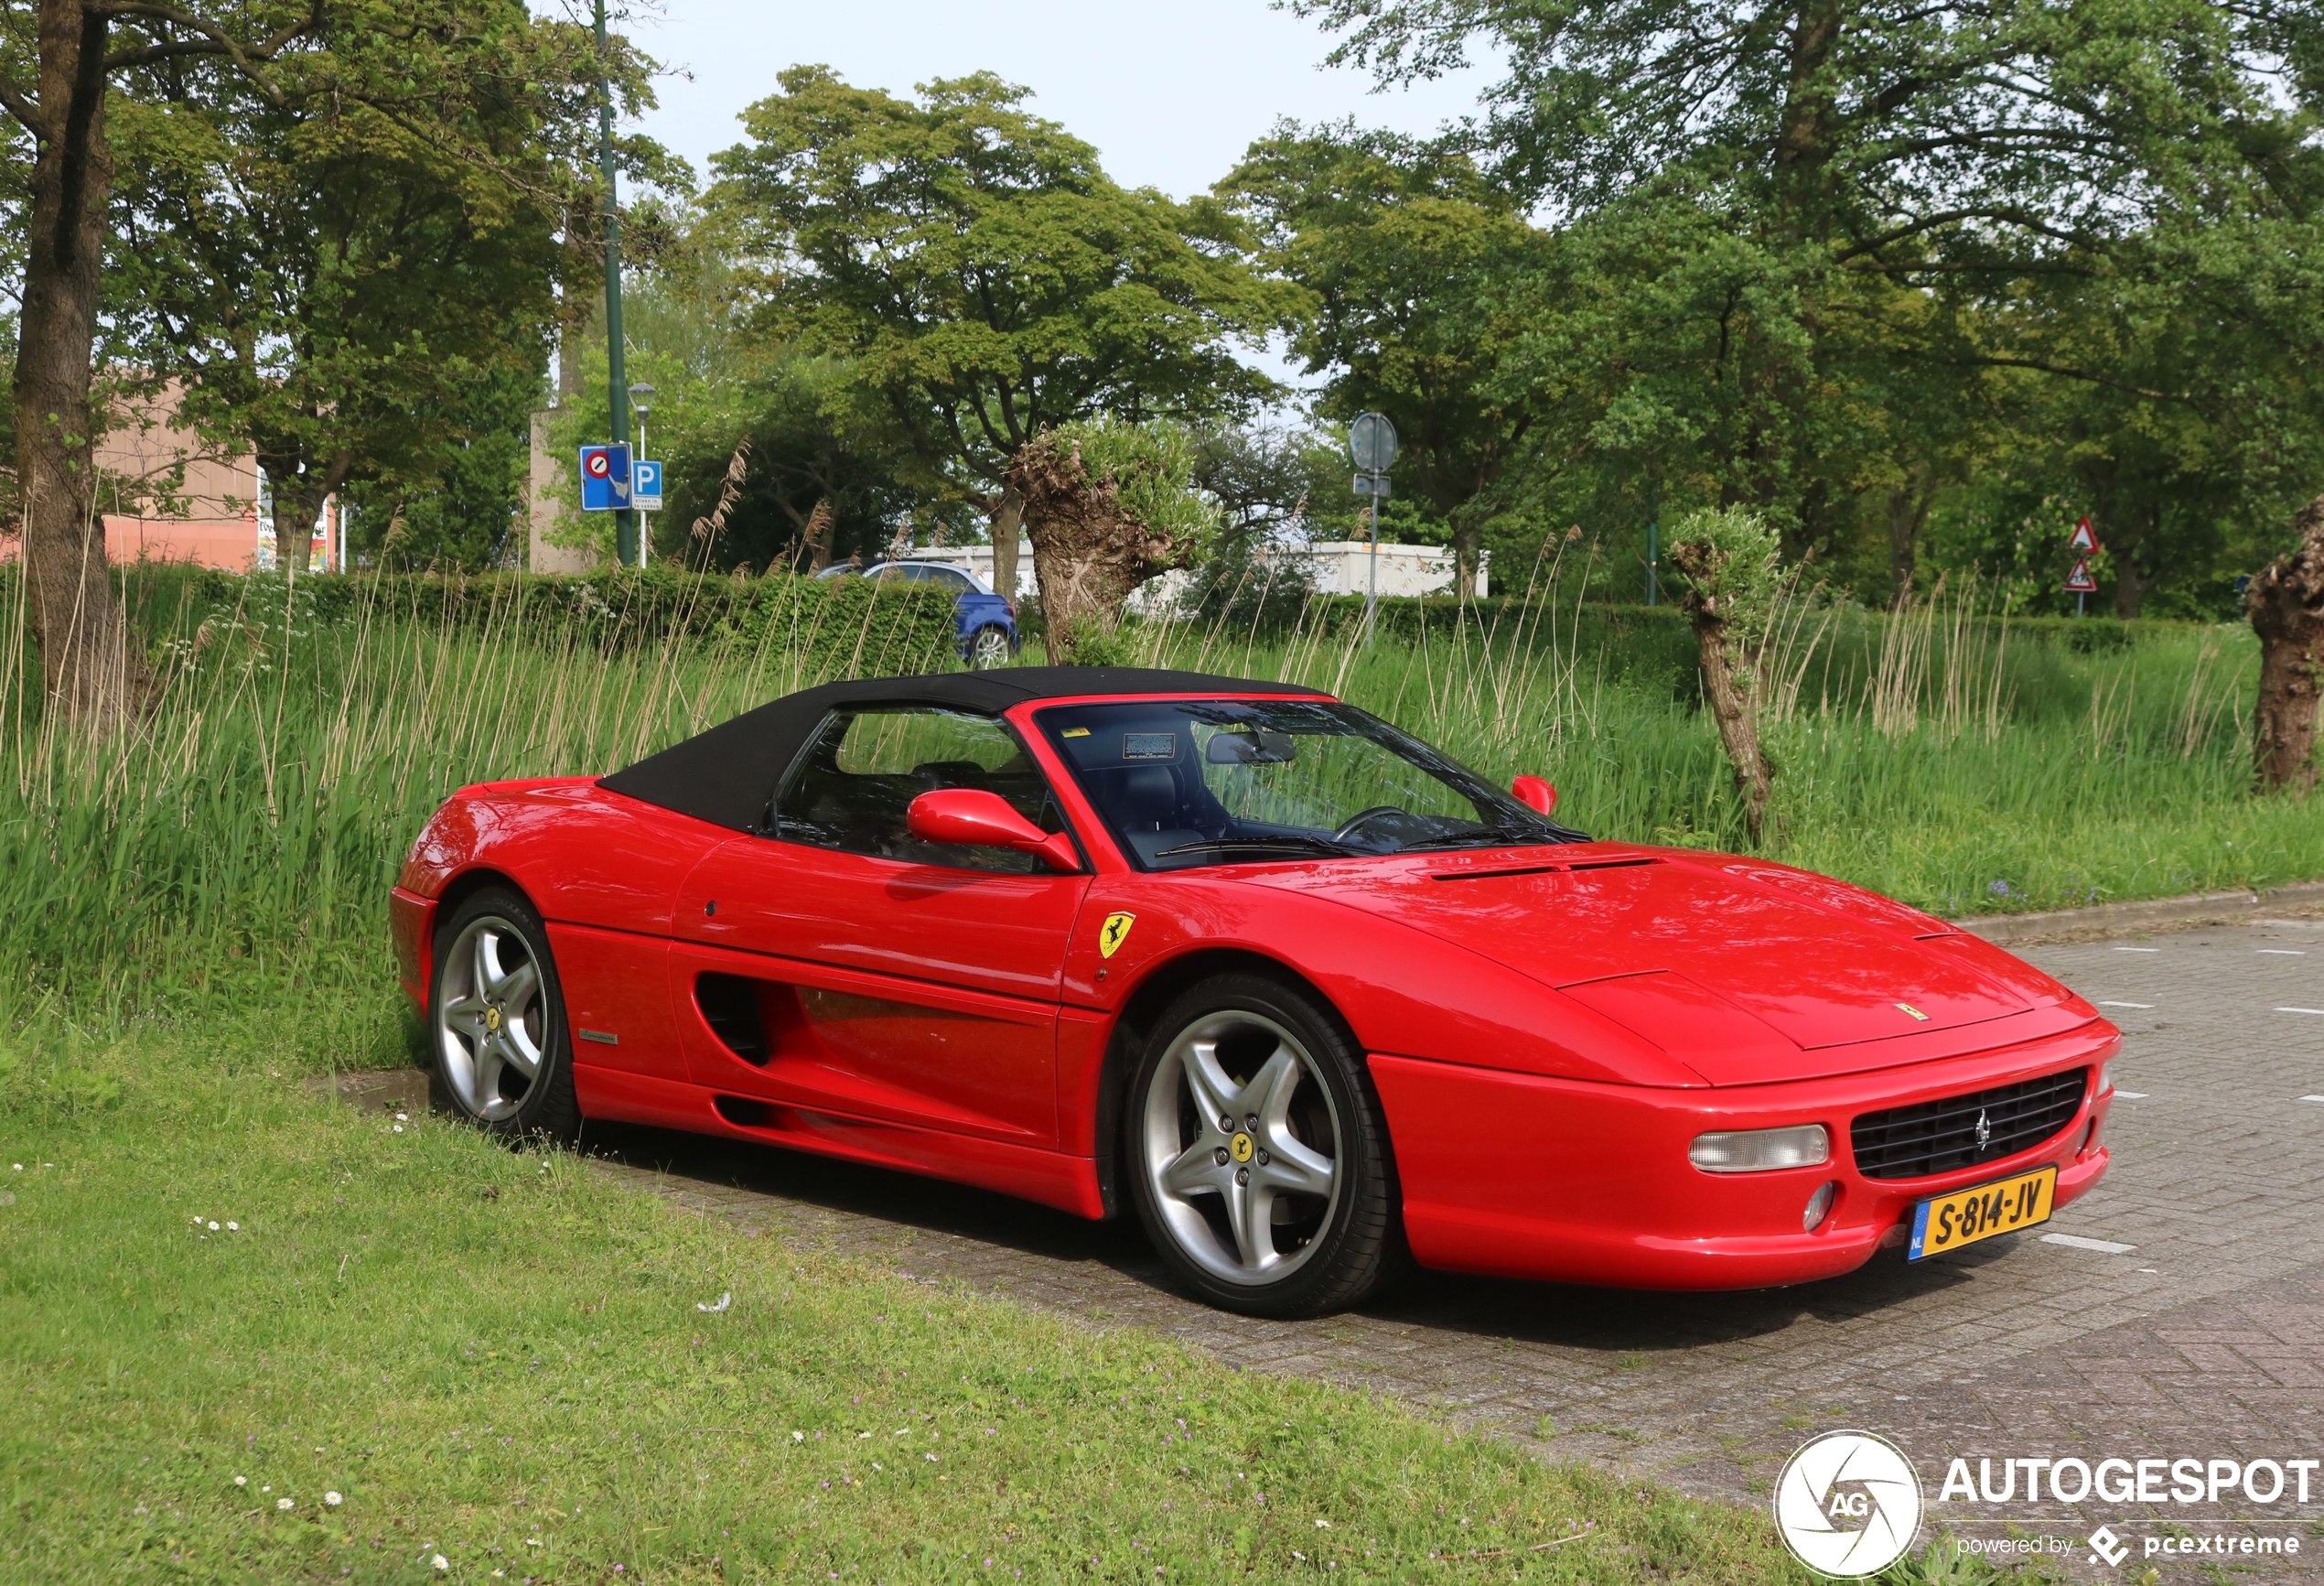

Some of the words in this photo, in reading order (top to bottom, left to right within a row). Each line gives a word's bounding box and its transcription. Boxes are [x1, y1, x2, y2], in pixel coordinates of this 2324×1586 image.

[637, 466, 655, 492] P
[1910, 1235, 1923, 1251] NL
[1935, 1178, 2043, 1246] S-814-JV
